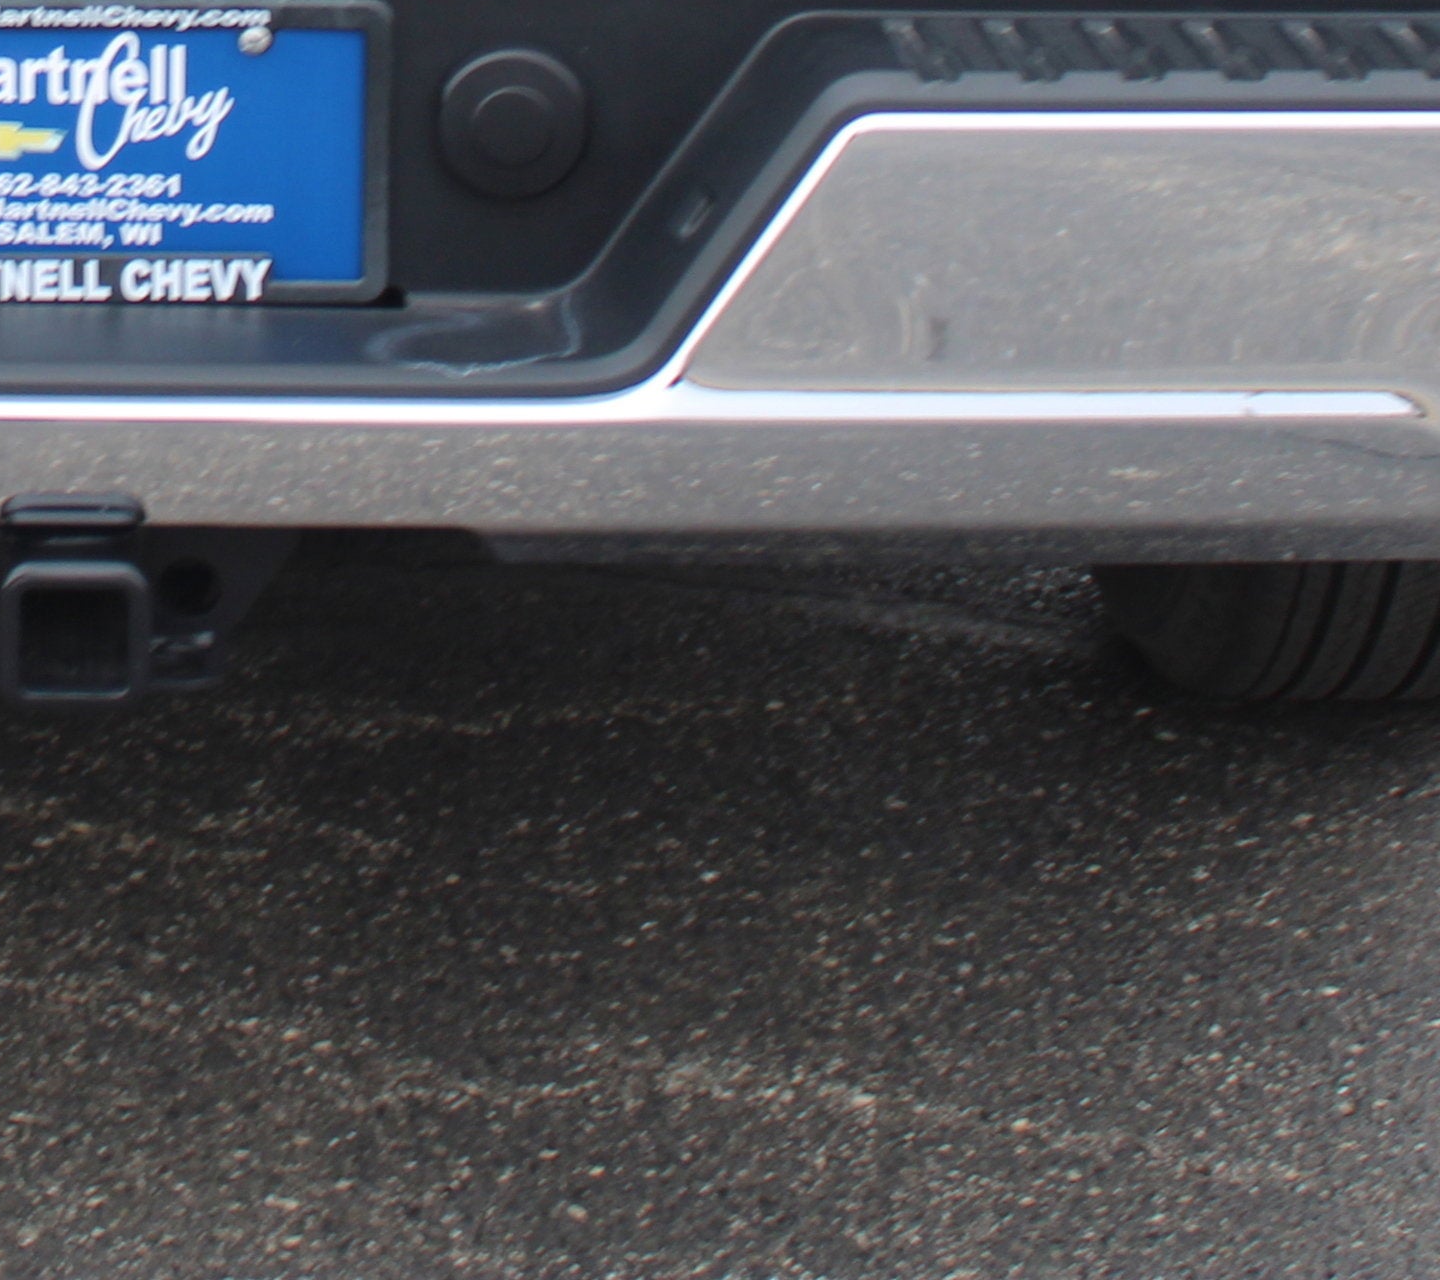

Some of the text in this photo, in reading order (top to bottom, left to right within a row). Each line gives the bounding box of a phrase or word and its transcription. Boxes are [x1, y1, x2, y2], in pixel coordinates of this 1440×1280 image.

[75, 30, 236, 172] Chevy
[118, 222, 164, 246] WI
[119, 258, 274, 303] CHEVY
